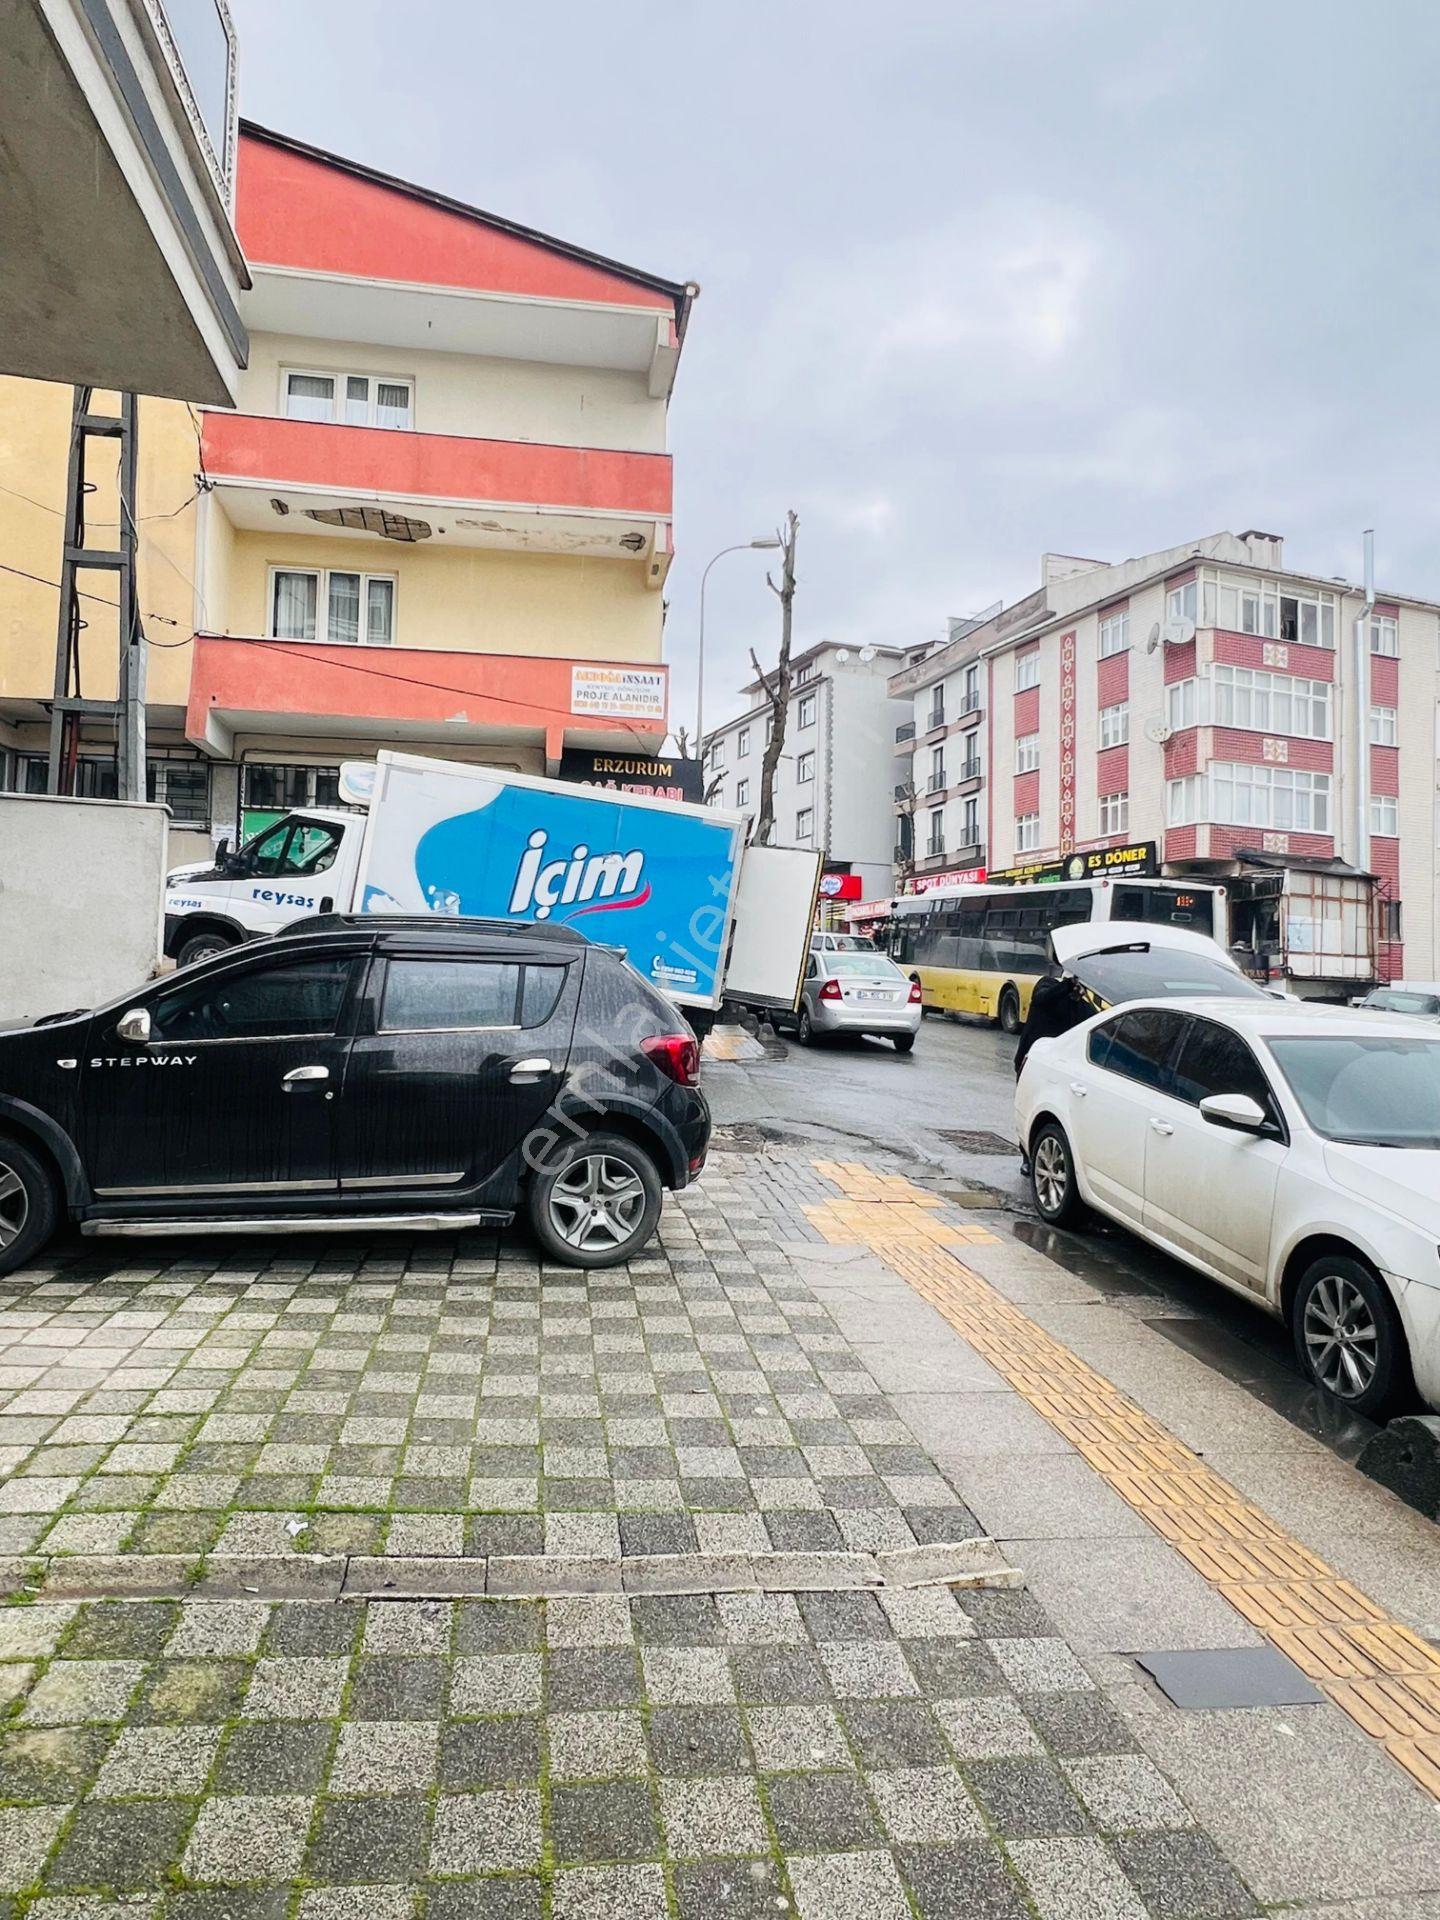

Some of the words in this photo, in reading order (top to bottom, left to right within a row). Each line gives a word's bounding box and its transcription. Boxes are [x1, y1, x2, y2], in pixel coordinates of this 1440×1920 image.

[576, 690, 609, 701] PROJE
[612, 692, 660, 704] ALANIDIR
[593, 758, 672, 777] ERZURUM
[1088, 855, 1101, 868] ES
[1105, 848, 1147, 865] DÖNER
[917, 877, 938, 891] SPOT
[940, 872, 979, 887] DÜNYASI
[252, 888, 315, 908] reysas
[90, 1056, 198, 1068] STEPWAY
